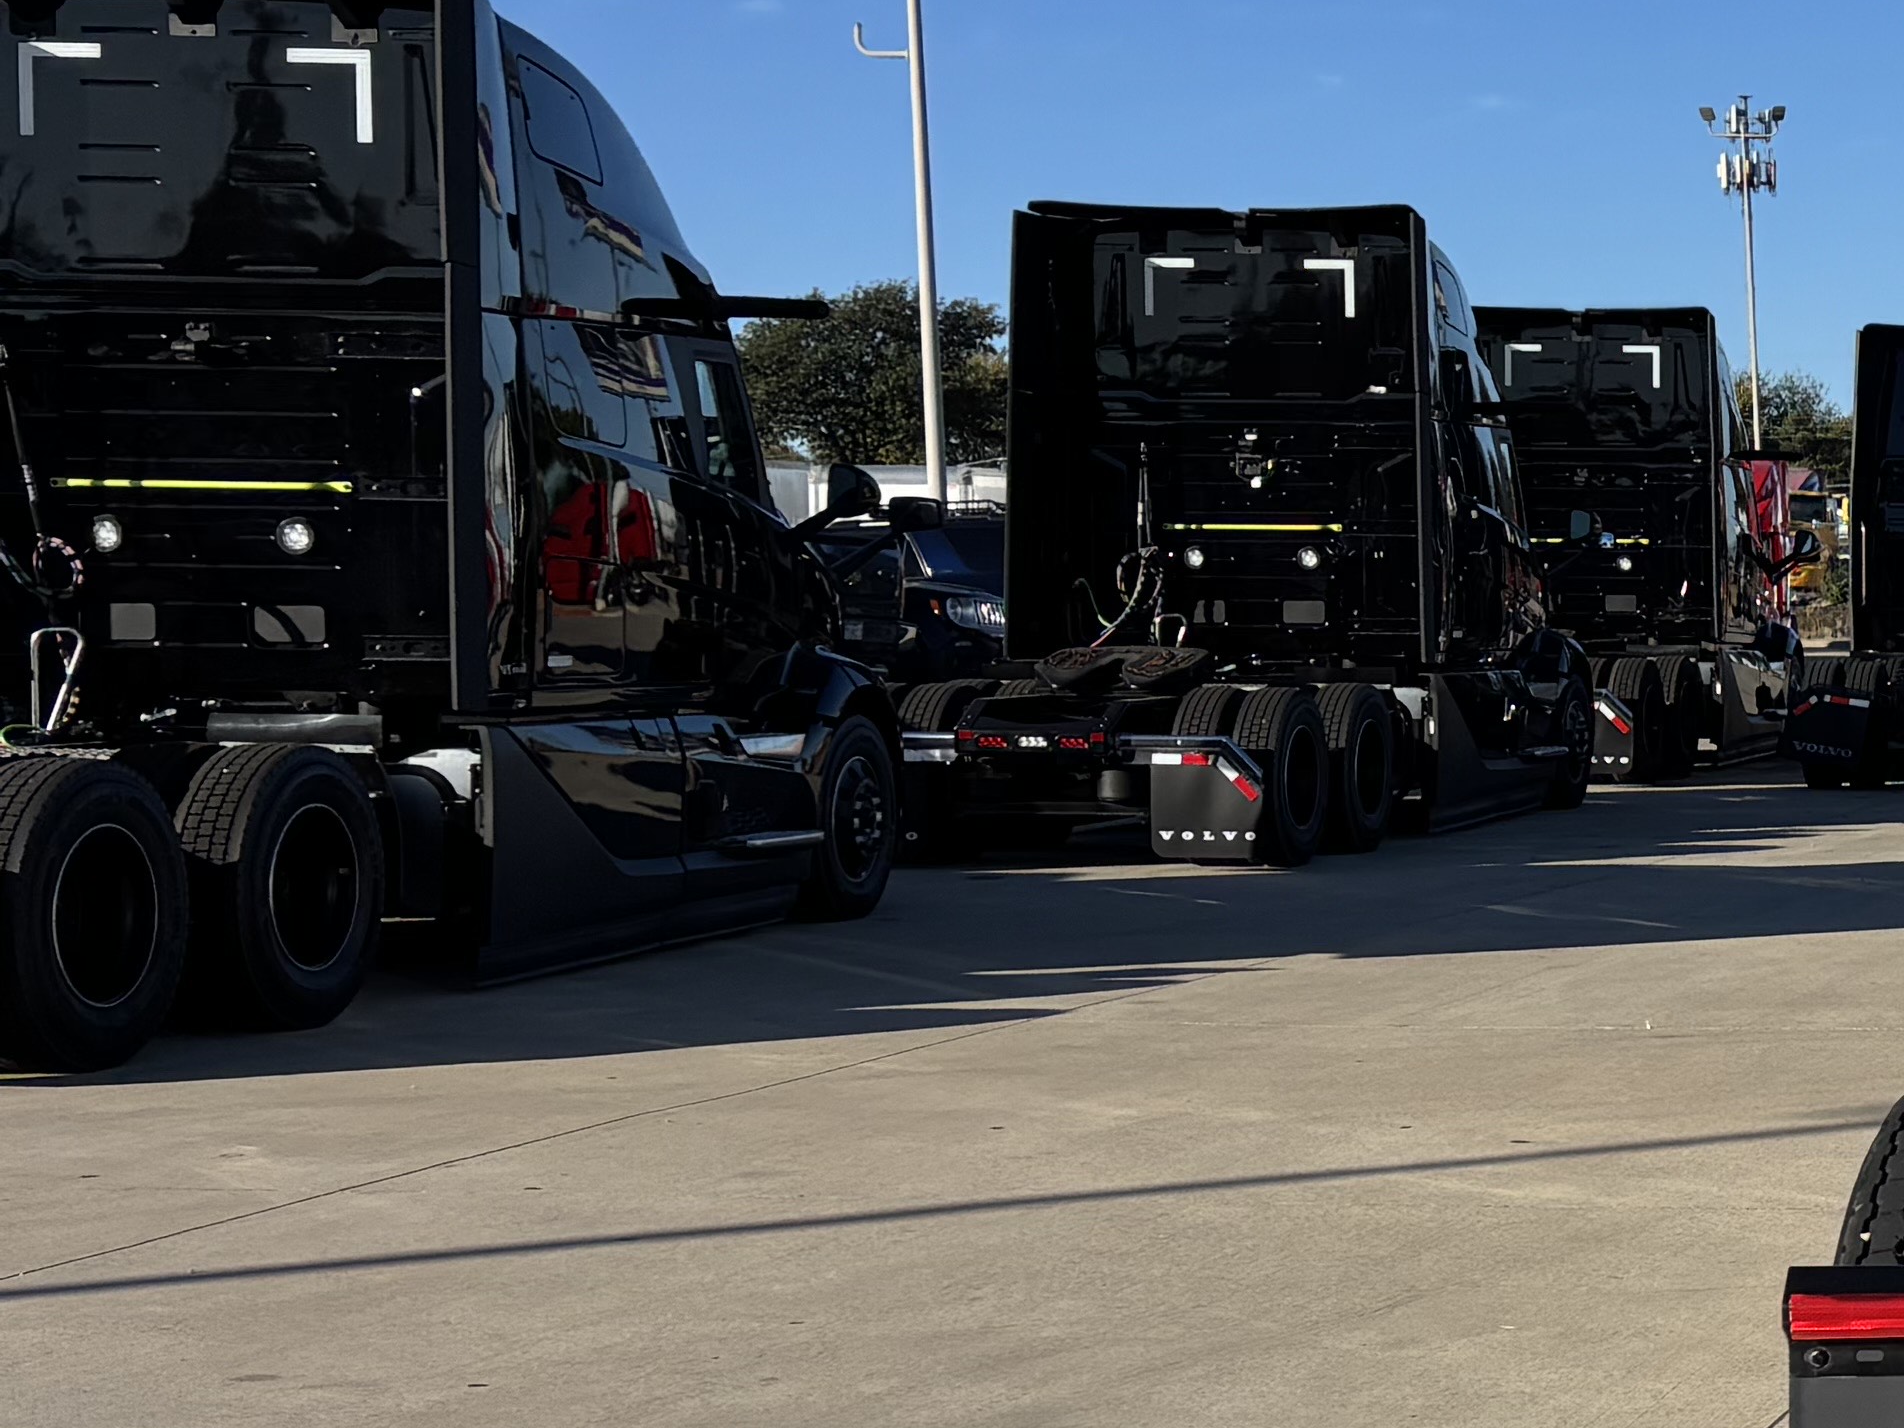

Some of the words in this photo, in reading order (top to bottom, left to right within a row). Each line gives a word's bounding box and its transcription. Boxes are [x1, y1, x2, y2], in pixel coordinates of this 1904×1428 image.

[1792, 740, 1852, 758] VOLVO
[1591, 756, 1629, 764] LVO
[1158, 830, 1257, 841] VOLVO
